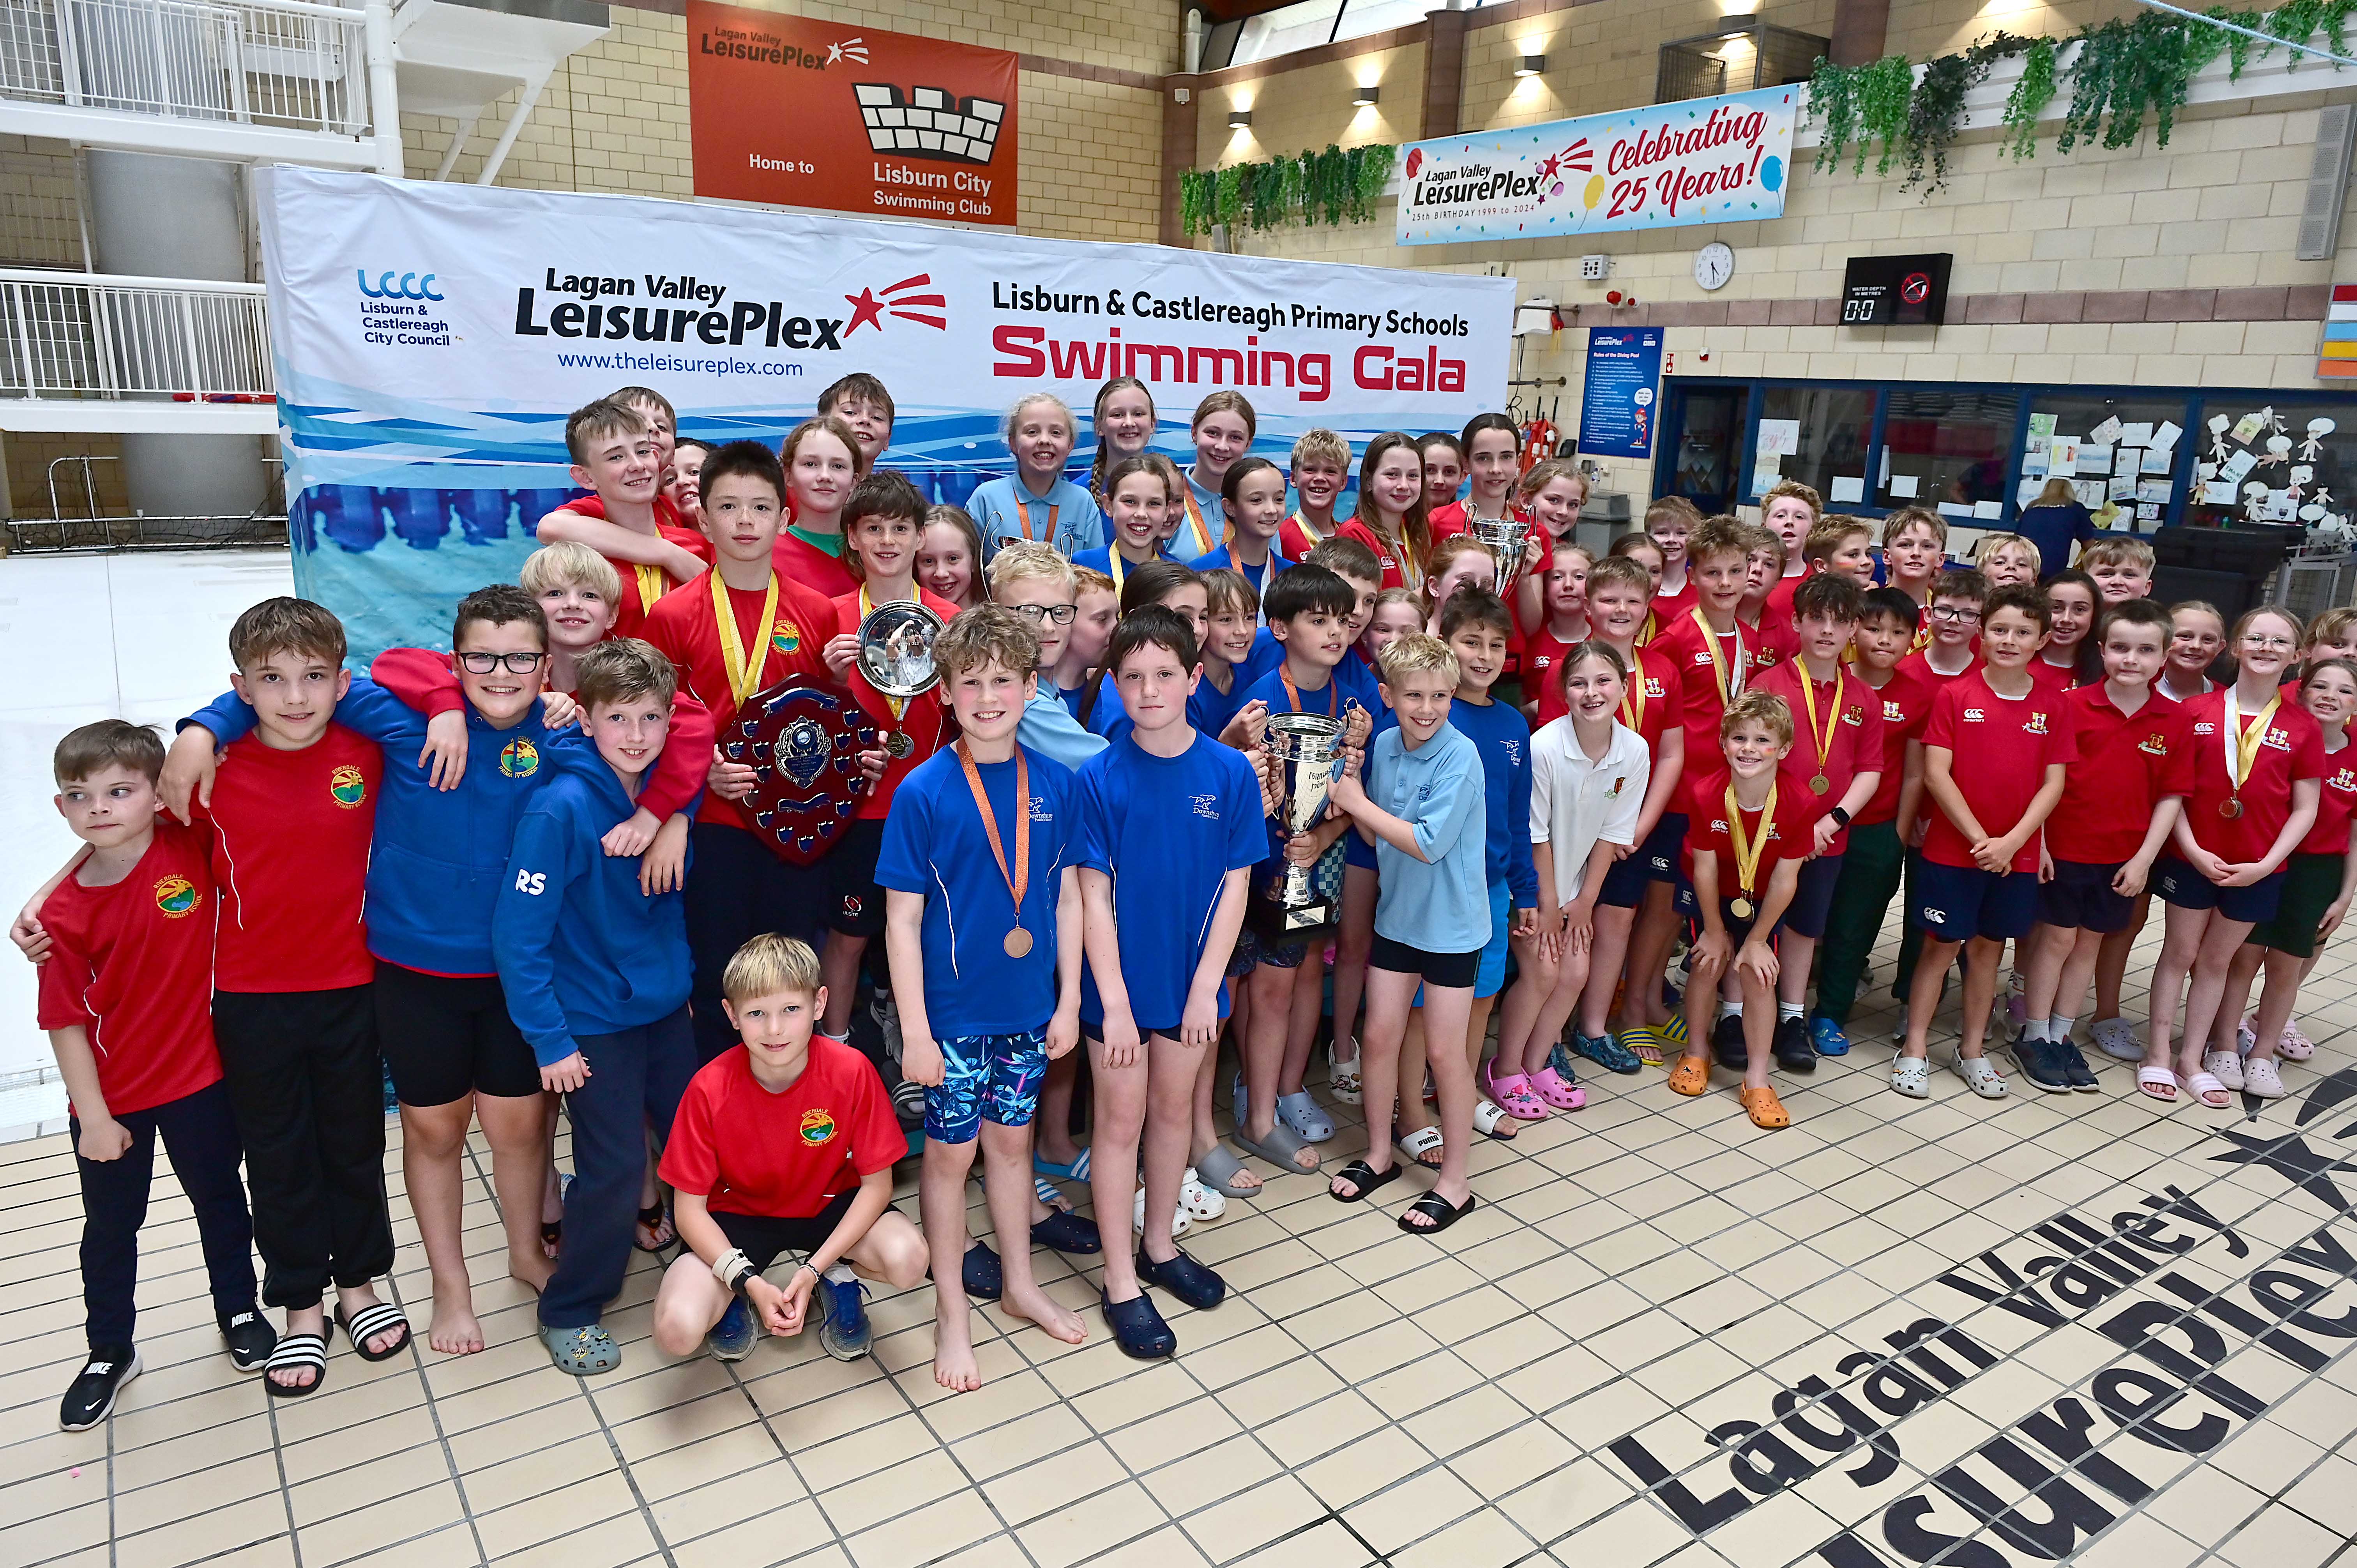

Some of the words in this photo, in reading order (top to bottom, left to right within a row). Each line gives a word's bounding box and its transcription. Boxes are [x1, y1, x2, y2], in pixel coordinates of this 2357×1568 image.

[715, 26, 746, 40] Lagan
[750, 32, 781, 46] Valley
[701, 33, 827, 71] LeisurePlex
[1608, 106, 1768, 176] Celebrating
[749, 154, 794, 171] Home
[798, 159, 815, 174] to
[1425, 170, 1457, 185] Lagan
[1461, 164, 1491, 179] Valley
[873, 161, 947, 188] Lisburn
[953, 171, 992, 197] City
[1413, 170, 1540, 206] LeisurePlex
[1606, 177, 1649, 219] 25
[1655, 145, 1764, 217] Years!
[873, 190, 955, 215] Swimming
[959, 198, 992, 215] Club
[1434, 209, 1475, 219] BIRTHDAY
[1478, 207, 1497, 216] 1999
[1514, 204, 1534, 213] 2024
[357, 269, 445, 301] LCCC
[546, 268, 634, 300] Lagan
[644, 274, 727, 308] Valley
[360, 302, 414, 315] Lisburn
[418, 305, 428, 315] &
[515, 287, 844, 351] LeisurePlex
[993, 281, 1099, 314] Lisburn
[1106, 289, 1126, 315] &
[1132, 291, 1285, 332] Castlereagh
[1290, 303, 1381, 338] Primary
[1385, 309, 1468, 336] Schools
[362, 317, 449, 333] Castlereagh
[364, 332, 393, 346] City
[397, 333, 450, 346] Council
[558, 352, 803, 377] www.theleisureplex.com
[992, 325, 1331, 401] Swimming
[1353, 345, 1466, 392] Gala
[331, 765, 360, 775] RIVERDALE
[333, 800, 354, 810] PRIMARY
[1193, 807, 1220, 818] Downshire
[153, 874, 184, 889] RIVERDALE
[515, 869, 546, 895] RS
[163, 911, 189, 919] PRIMARY
[189, 893, 203, 913] SCHOOL
[801, 1108, 829, 1118] RIVERDALE
[1417, 1135, 1439, 1147] PUMA
[231, 1312, 254, 1328] NIKE
[1608, 1317, 2004, 1533] Lagan
[1936, 1185, 2249, 1330] Valley
